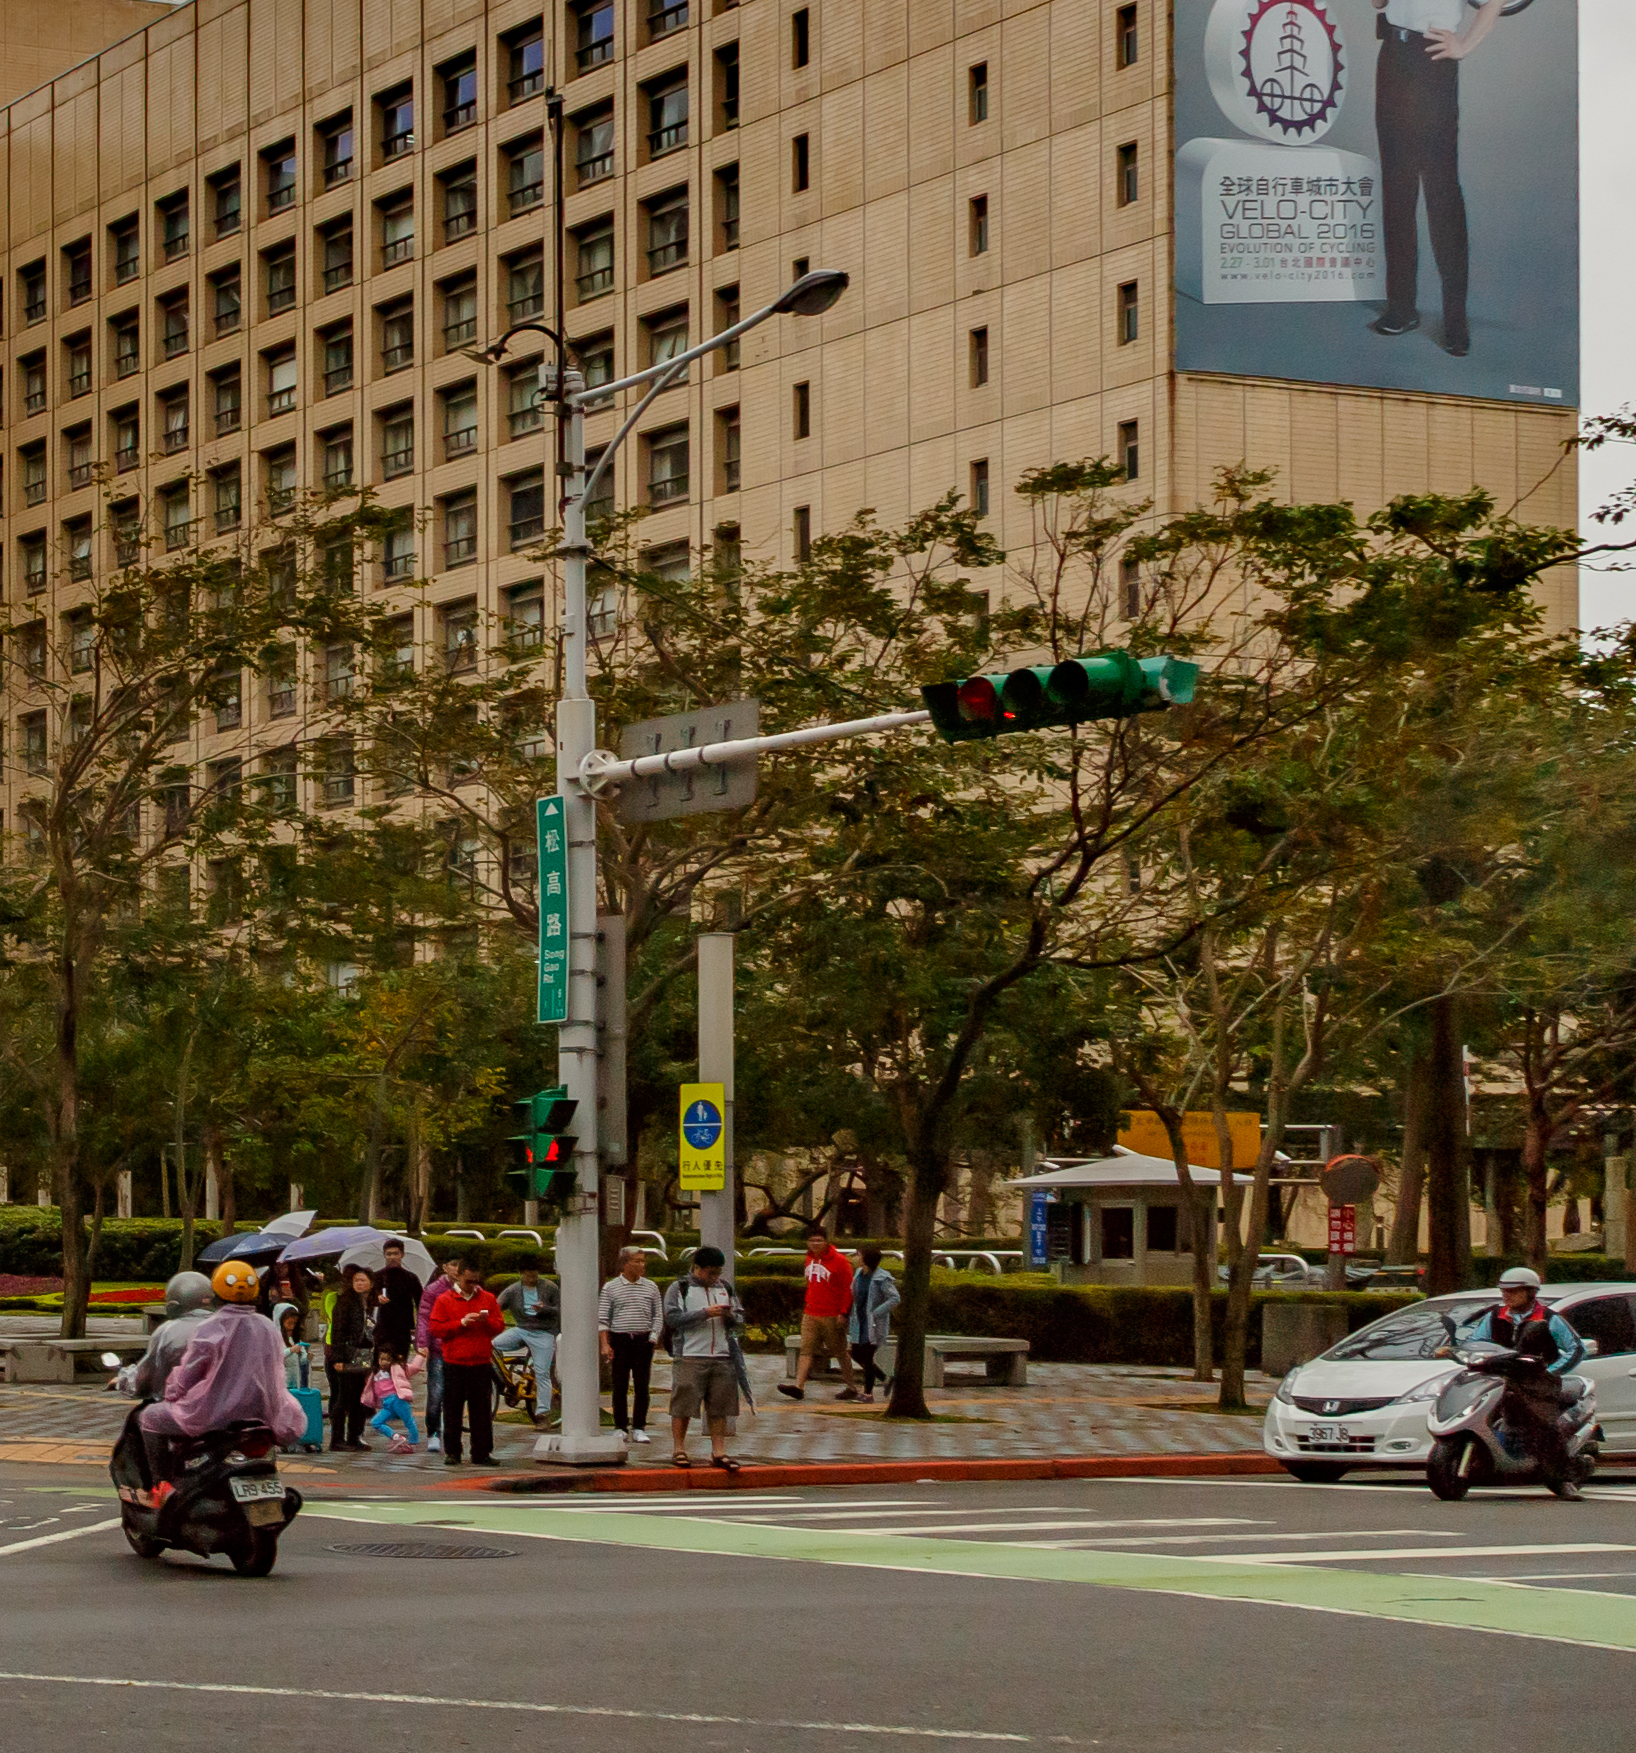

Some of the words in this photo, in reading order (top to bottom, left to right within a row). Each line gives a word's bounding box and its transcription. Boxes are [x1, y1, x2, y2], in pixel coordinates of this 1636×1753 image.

[1219, 176, 1375, 197] 全球自行車城市大會
[1220, 199, 1374, 220] VELO-CITY
[1220, 223, 1310, 239] GLOBAL
[1317, 223, 1375, 239] 2016
[1220, 242, 1293, 254] EVOLUTION
[1297, 242, 1315, 254] OF
[1320, 242, 1376, 254] CYCLING
[1220, 257, 1243, 268] 2.27
[1220, 270, 1376, 282] www.velo-city2016.com
[545, 829, 562, 938] 松高路
[544, 949, 565, 960] Song
[682, 1159, 724, 1171] 行人優先
